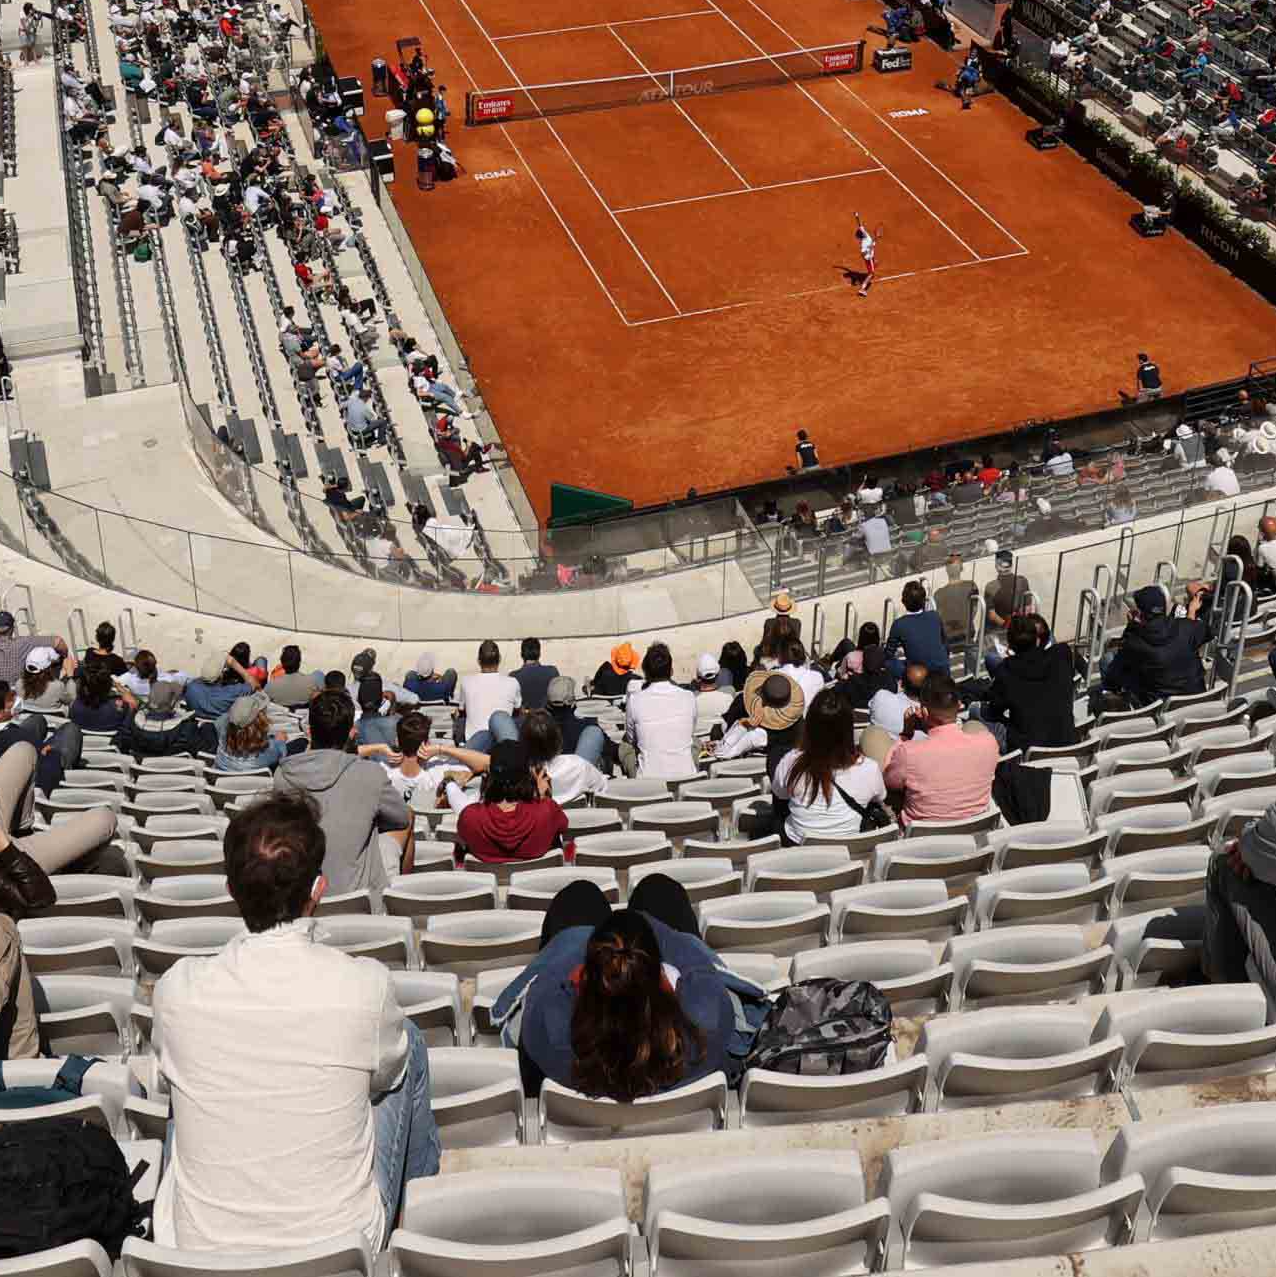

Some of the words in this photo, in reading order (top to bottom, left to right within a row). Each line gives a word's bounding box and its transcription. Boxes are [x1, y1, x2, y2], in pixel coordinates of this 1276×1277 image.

[674, 81, 714, 95] TOUR
[478, 99, 511, 111] Emirates
[887, 108, 931, 119] ROMA
[474, 168, 516, 180] ROMA
[1200, 224, 1239, 260] RICOH
